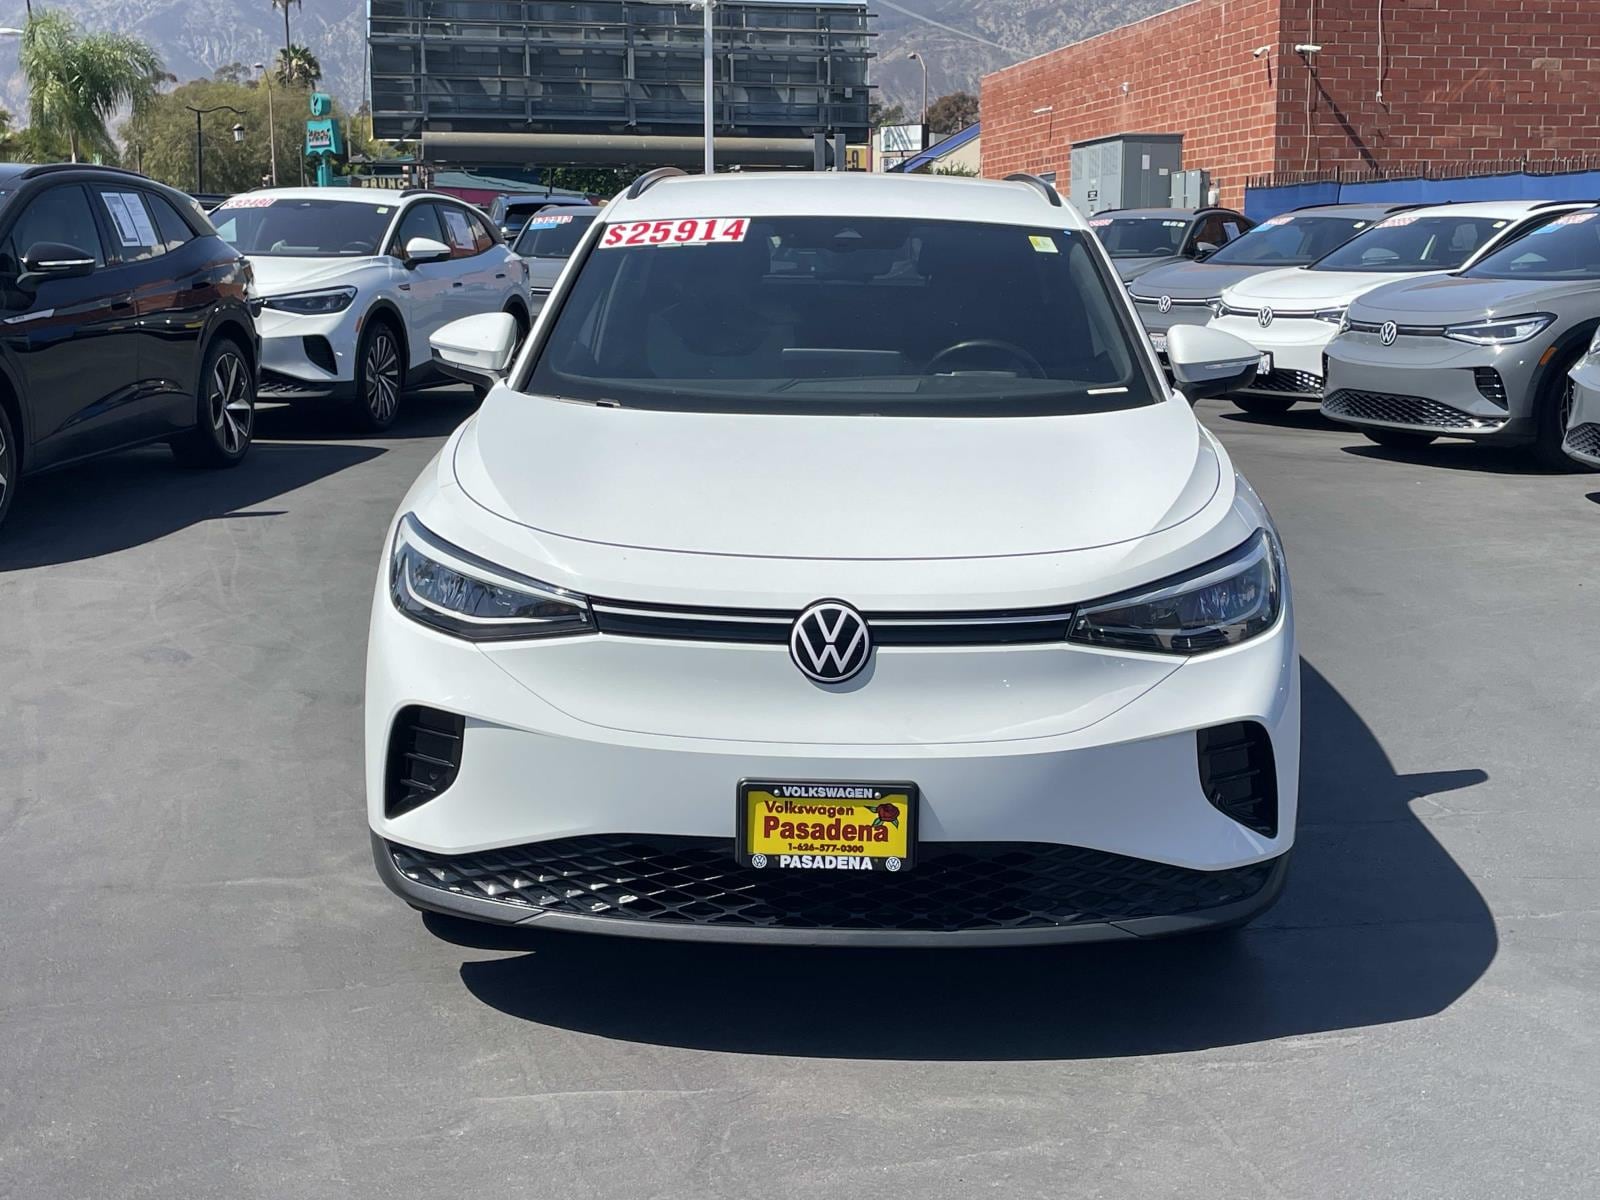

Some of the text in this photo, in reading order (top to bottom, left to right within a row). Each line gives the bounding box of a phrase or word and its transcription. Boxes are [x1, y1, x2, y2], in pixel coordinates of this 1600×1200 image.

[605, 218, 745, 245] $25914
[793, 605, 868, 679] VW
[782, 786, 873, 799] VOLKSWAGEN
[764, 800, 855, 818] Volkswagen
[763, 815, 889, 842] Pasadena
[788, 843, 864, 853] 1-626-577-0300
[780, 855, 872, 870] PASADENA
